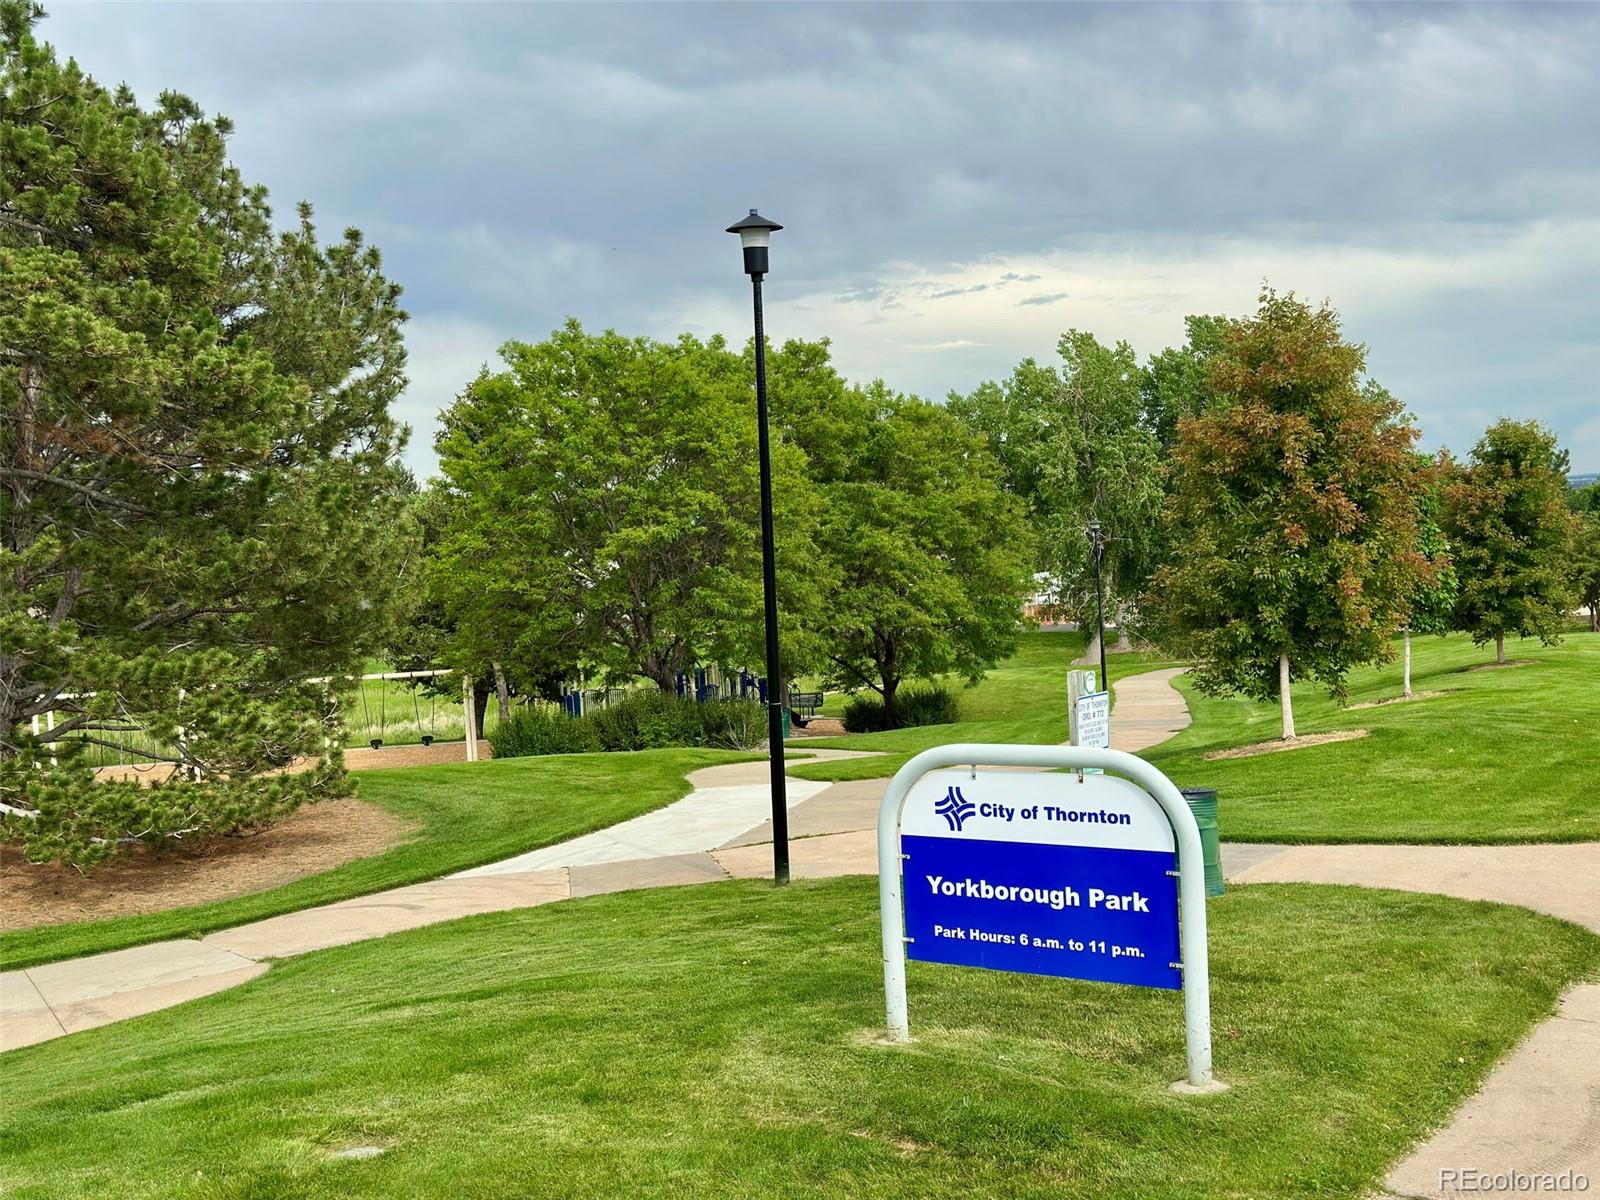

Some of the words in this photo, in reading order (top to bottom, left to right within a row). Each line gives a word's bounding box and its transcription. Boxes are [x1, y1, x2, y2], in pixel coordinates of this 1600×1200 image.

[979, 803, 1014, 822] City
[1021, 804, 1038, 821] of
[1044, 806, 1131, 825] Thornton
[926, 876, 1080, 910] Yorkborough
[1089, 889, 1149, 912] Park
[934, 925, 965, 940] Park
[969, 928, 1015, 945] Hours:
[1019, 933, 1028, 946] 6
[1033, 937, 1064, 950] a.m.
[1069, 939, 1084, 952] to
[1089, 941, 1105, 954] 11
[1112, 945, 1145, 959] p.m.
